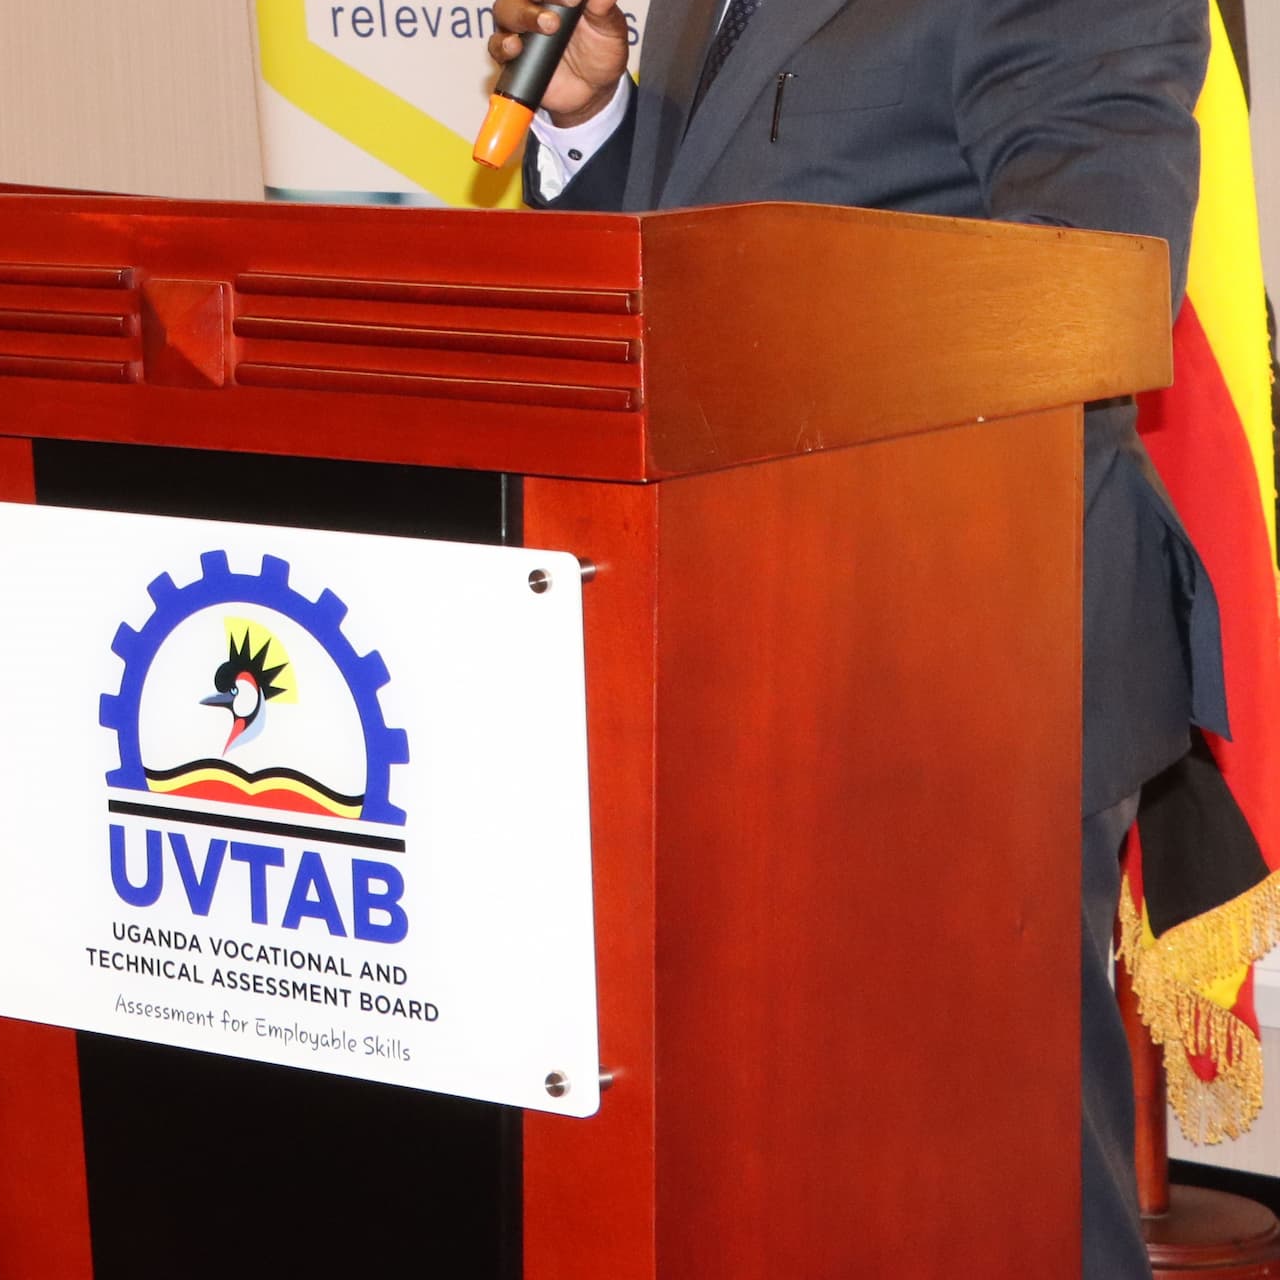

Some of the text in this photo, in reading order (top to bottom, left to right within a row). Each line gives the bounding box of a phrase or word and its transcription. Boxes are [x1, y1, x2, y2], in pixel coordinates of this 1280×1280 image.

[109, 823, 409, 944] UVTAB
[86, 947, 439, 1022] TECHNICAL ASSESSMENT BOARD
[113, 921, 407, 985] UGANDA VOCATIONAL AND
[115, 993, 411, 1062] Assessment for Employable Skills
